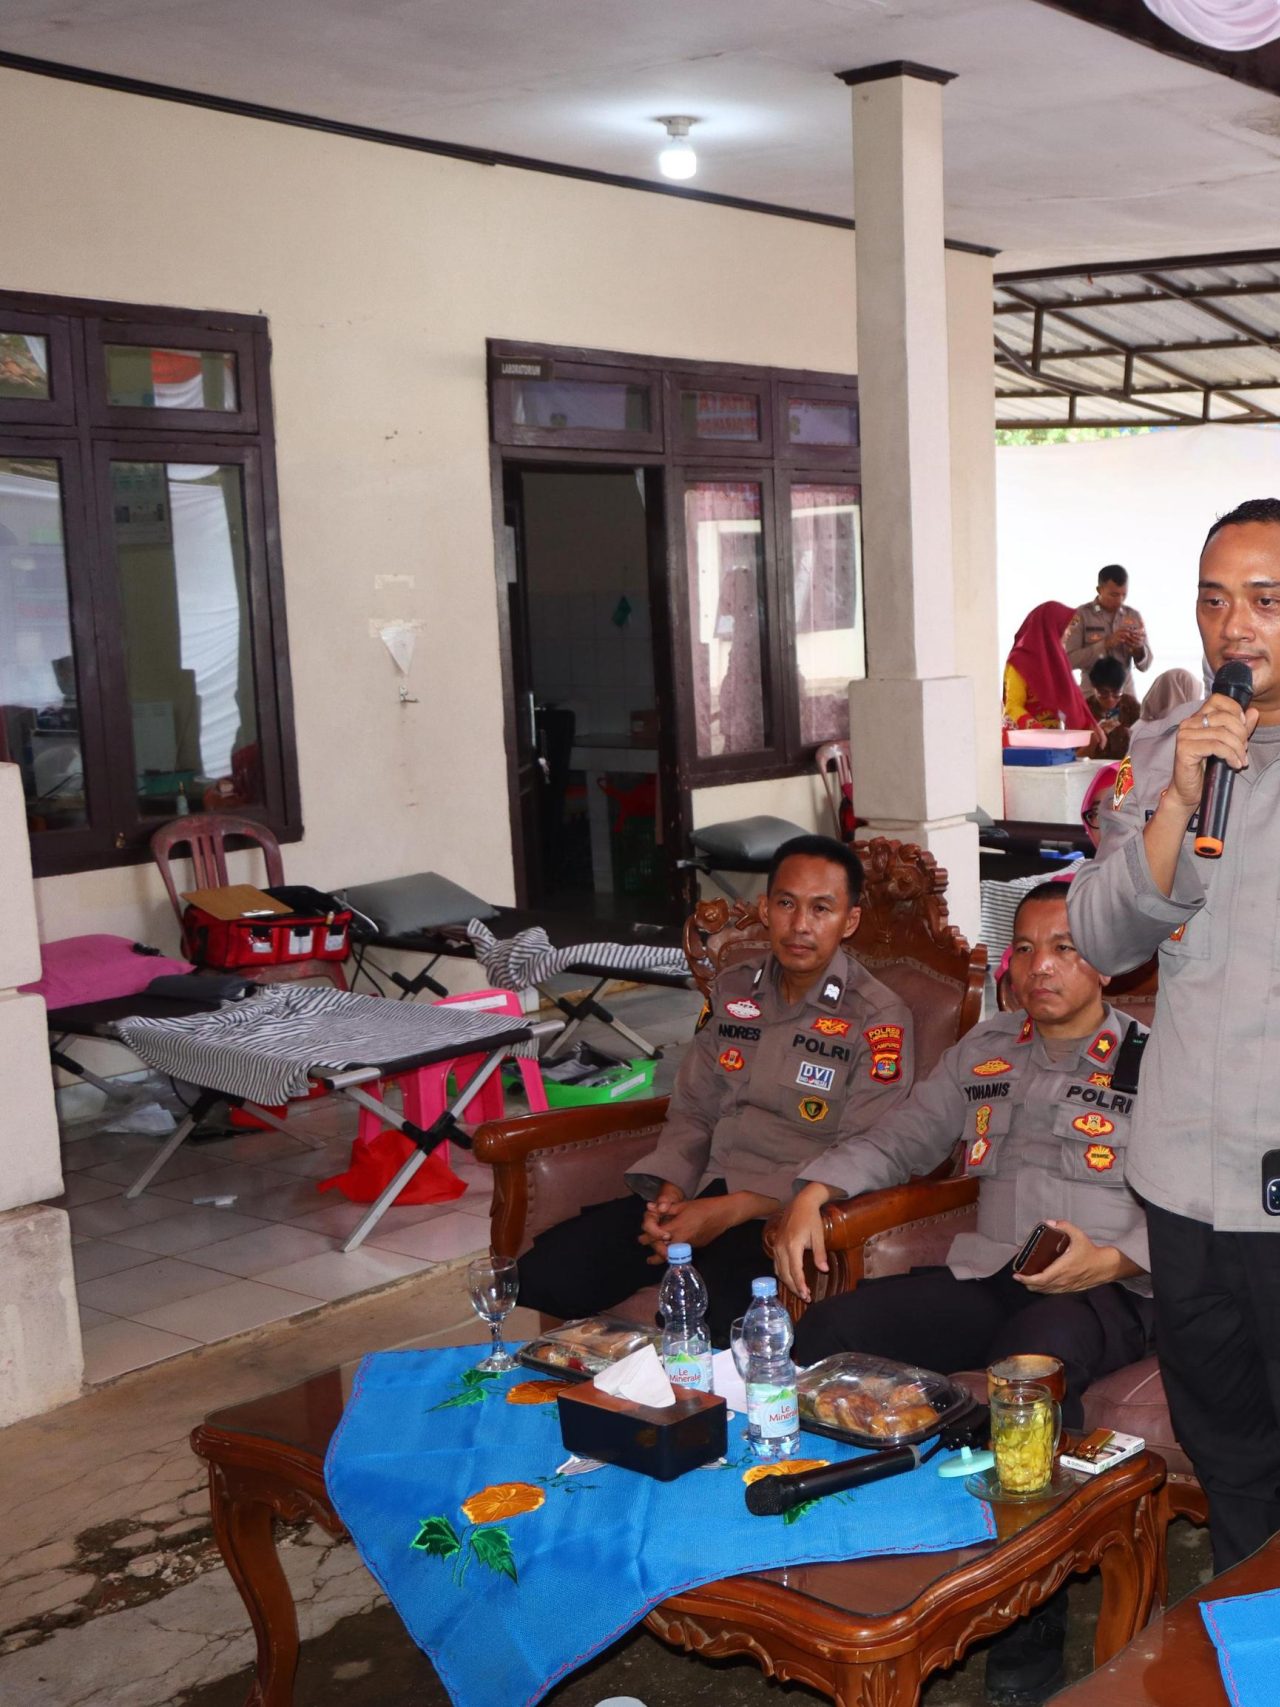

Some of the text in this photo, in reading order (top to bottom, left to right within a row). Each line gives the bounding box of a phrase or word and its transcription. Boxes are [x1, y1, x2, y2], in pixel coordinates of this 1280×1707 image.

[868, 1027, 900, 1040] POLRES
[792, 1033, 850, 1062] POLRI
[803, 1064, 830, 1082] DVI
[1066, 1085, 1134, 1114] POLRI
[678, 1368, 688, 1376] Le
[781, 1405, 791, 1413] Le
